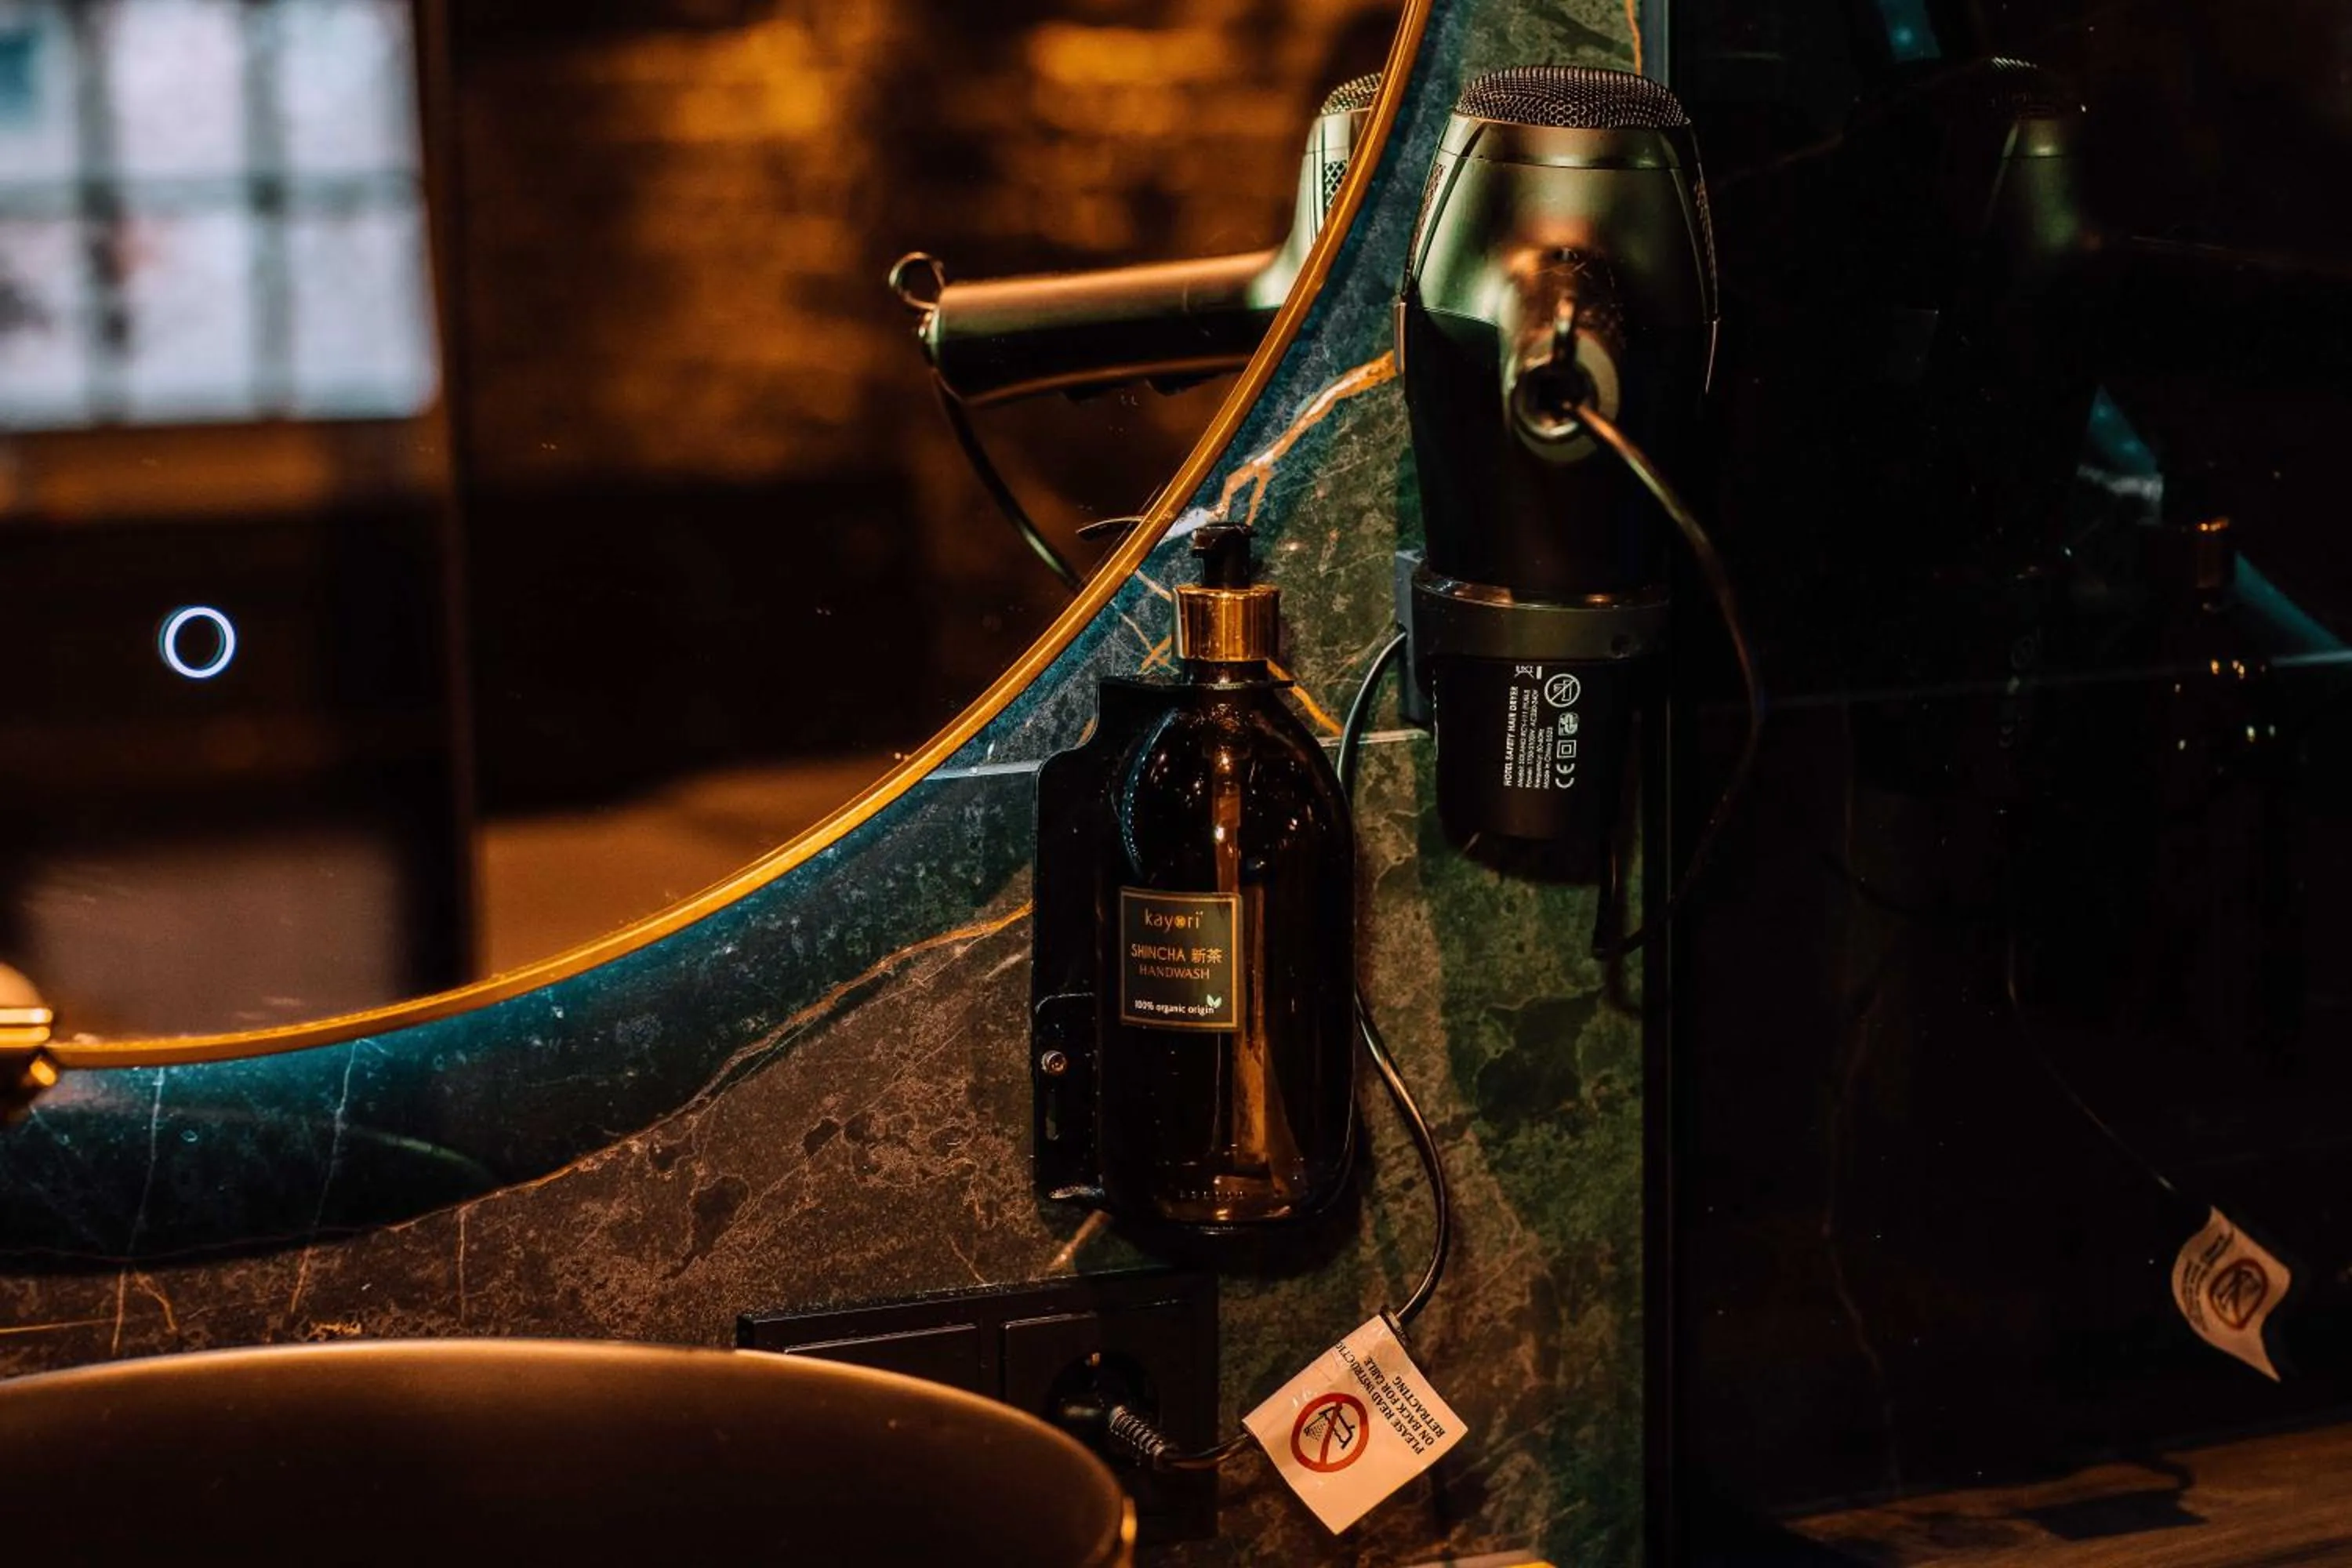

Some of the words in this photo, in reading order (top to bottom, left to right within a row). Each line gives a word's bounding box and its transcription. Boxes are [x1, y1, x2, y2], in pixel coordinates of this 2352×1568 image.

[1509, 686, 1519, 710] DRYER
[1508, 713, 1516, 731] HAIR
[1505, 732, 1515, 761] SAFETY
[1504, 763, 1512, 786] HOTEL
[1145, 908, 1201, 933] kayori
[1131, 944, 1185, 962] SHINCHA
[1191, 947, 1223, 964] 新茶
[1139, 964, 1210, 979] HANDWASH
[1134, 1000, 1154, 1011] 100%
[1156, 1004, 1185, 1014] organic
[1188, 1005, 1214, 1016] origin
[1363, 1356, 1385, 1385] CABLE
[1381, 1382, 1399, 1405] FOR
[1371, 1392, 1395, 1420] READ
[1392, 1376, 1446, 1438] RETRACTING
[1396, 1403, 1422, 1431] BACK
[1390, 1417, 1425, 1454] PLEASE
[1418, 1428, 1435, 1446] ON
